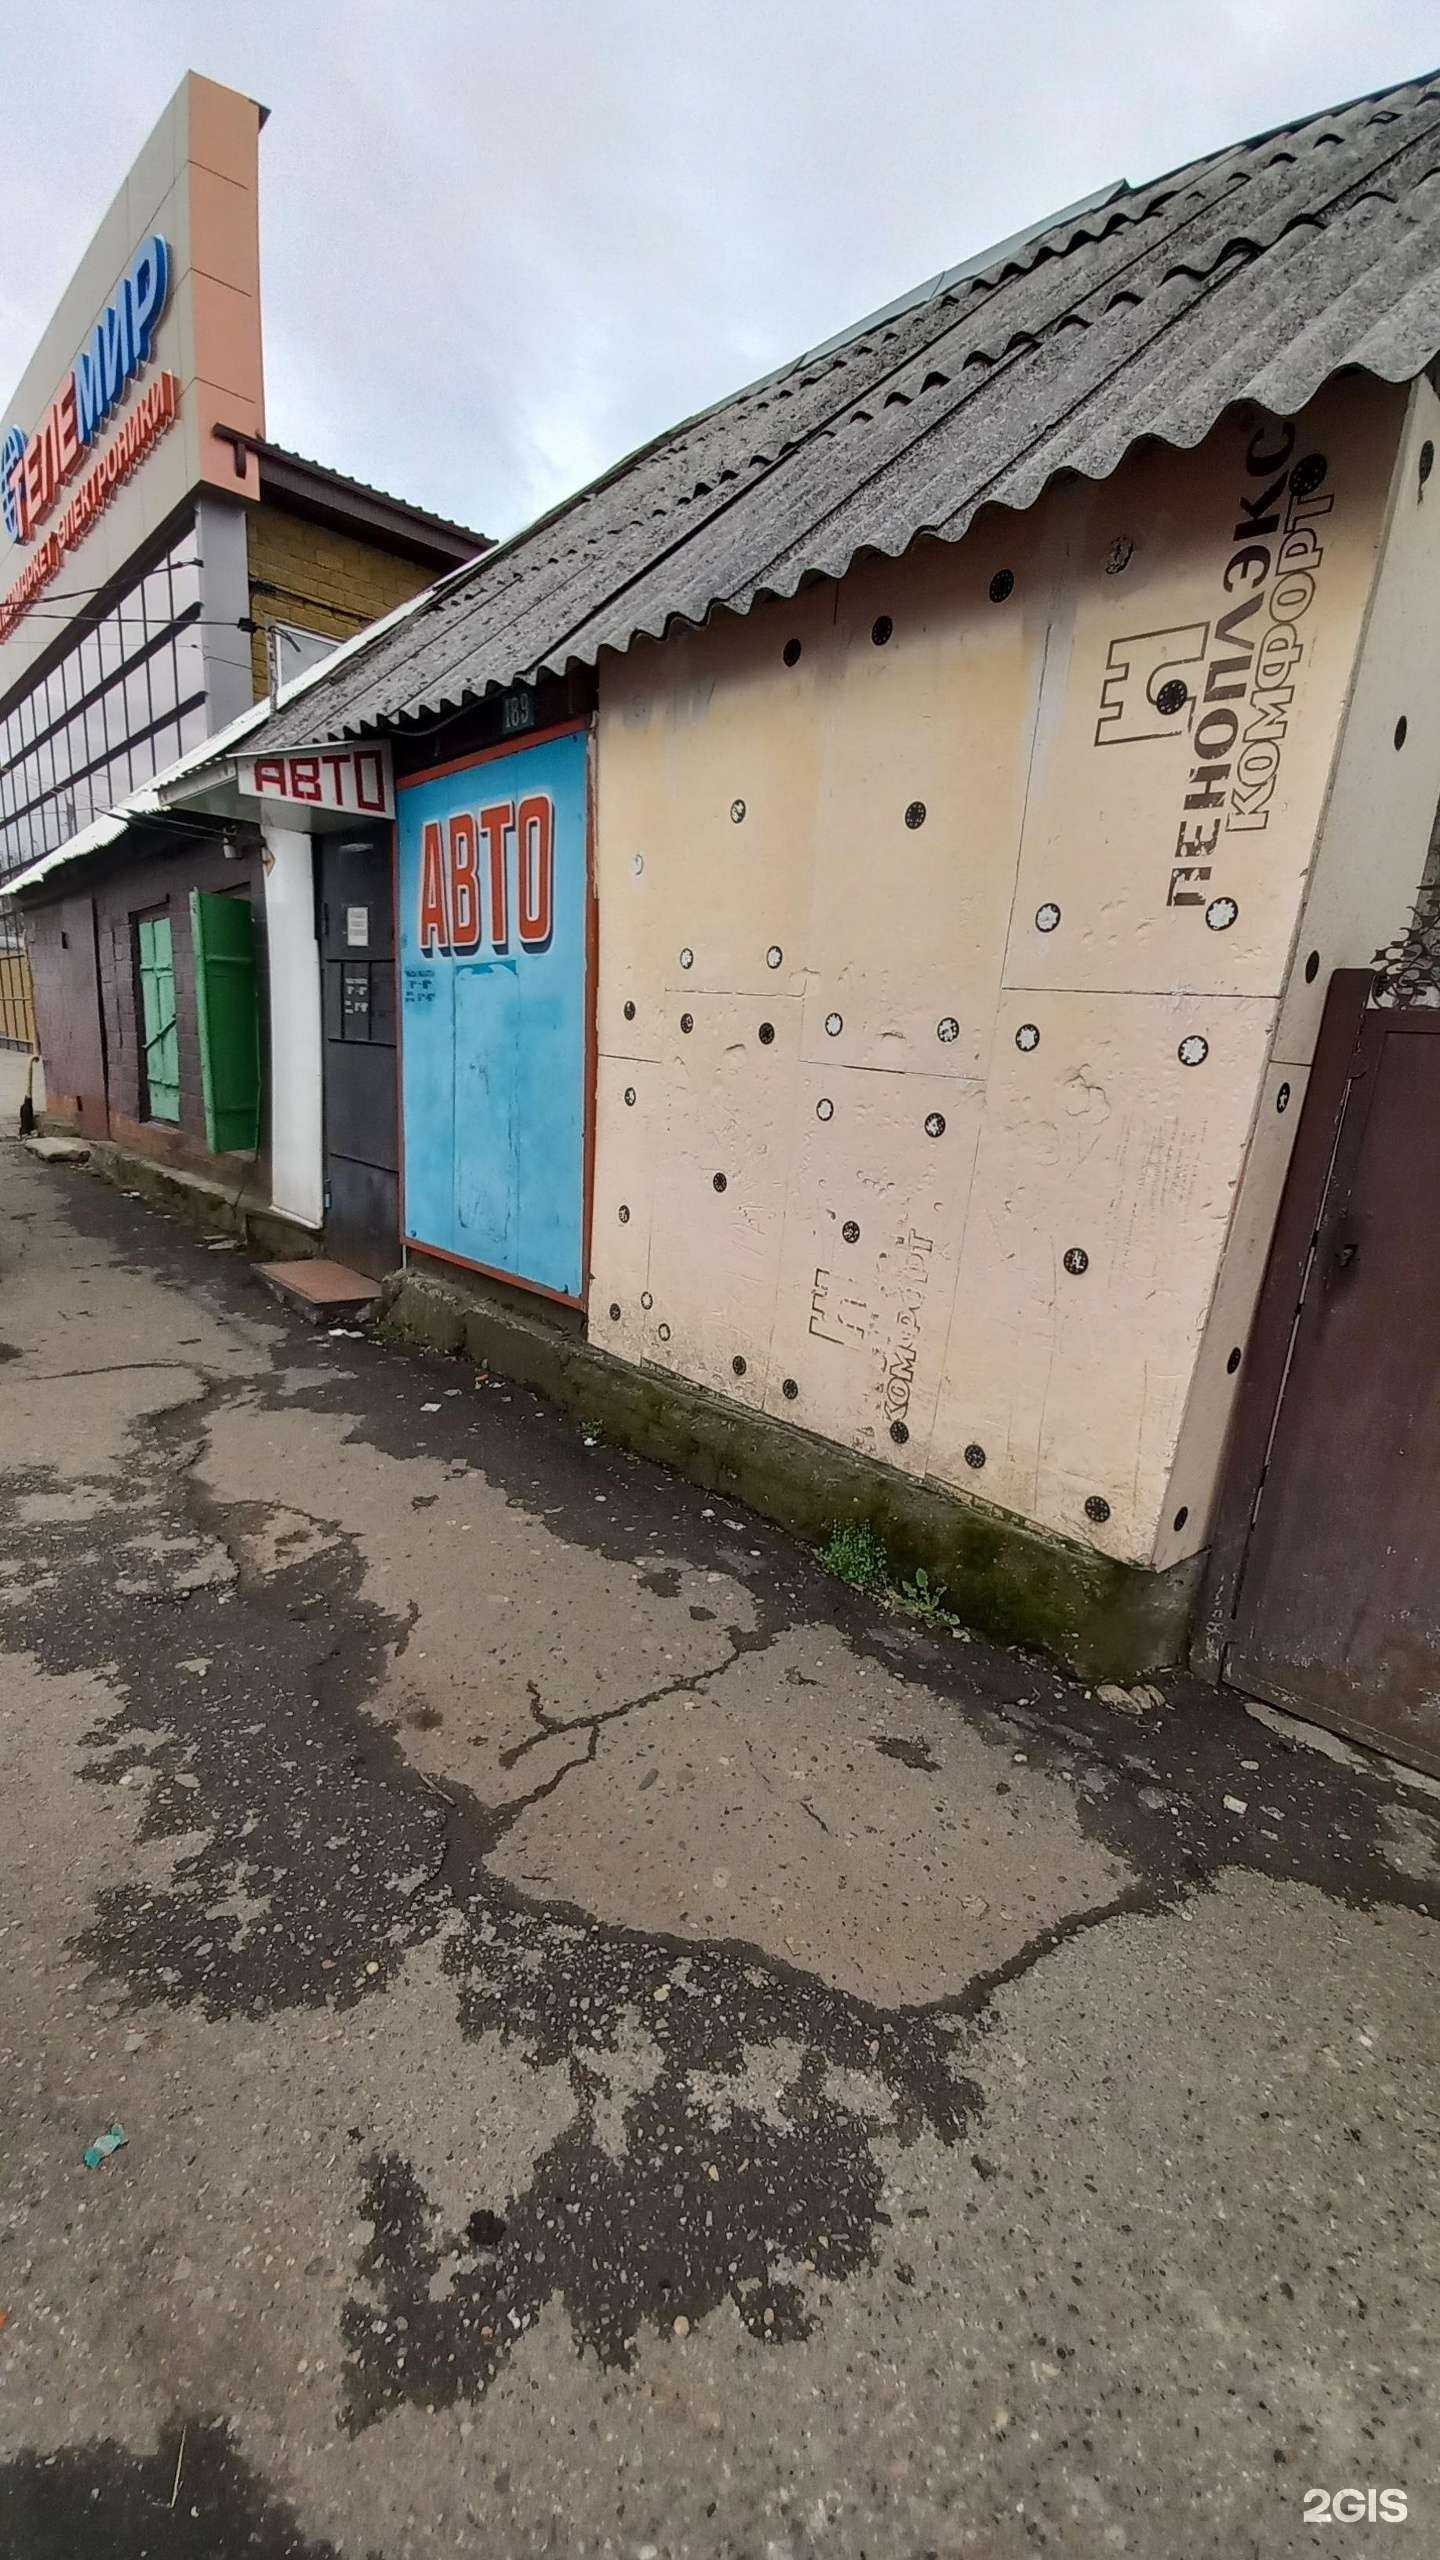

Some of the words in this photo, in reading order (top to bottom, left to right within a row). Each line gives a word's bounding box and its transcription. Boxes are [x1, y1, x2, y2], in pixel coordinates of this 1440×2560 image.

[9, 233, 171, 542] ТЕЛЕМИР
[57, 370, 176, 549] ЭЛЕКТРОНИКИ
[254, 750, 386, 813] АВТО
[1167, 421, 1296, 907] ПЕНОПЛЭКС
[1226, 488, 1335, 832] КОМФОРТ
[420, 794, 554, 957] АВТО
